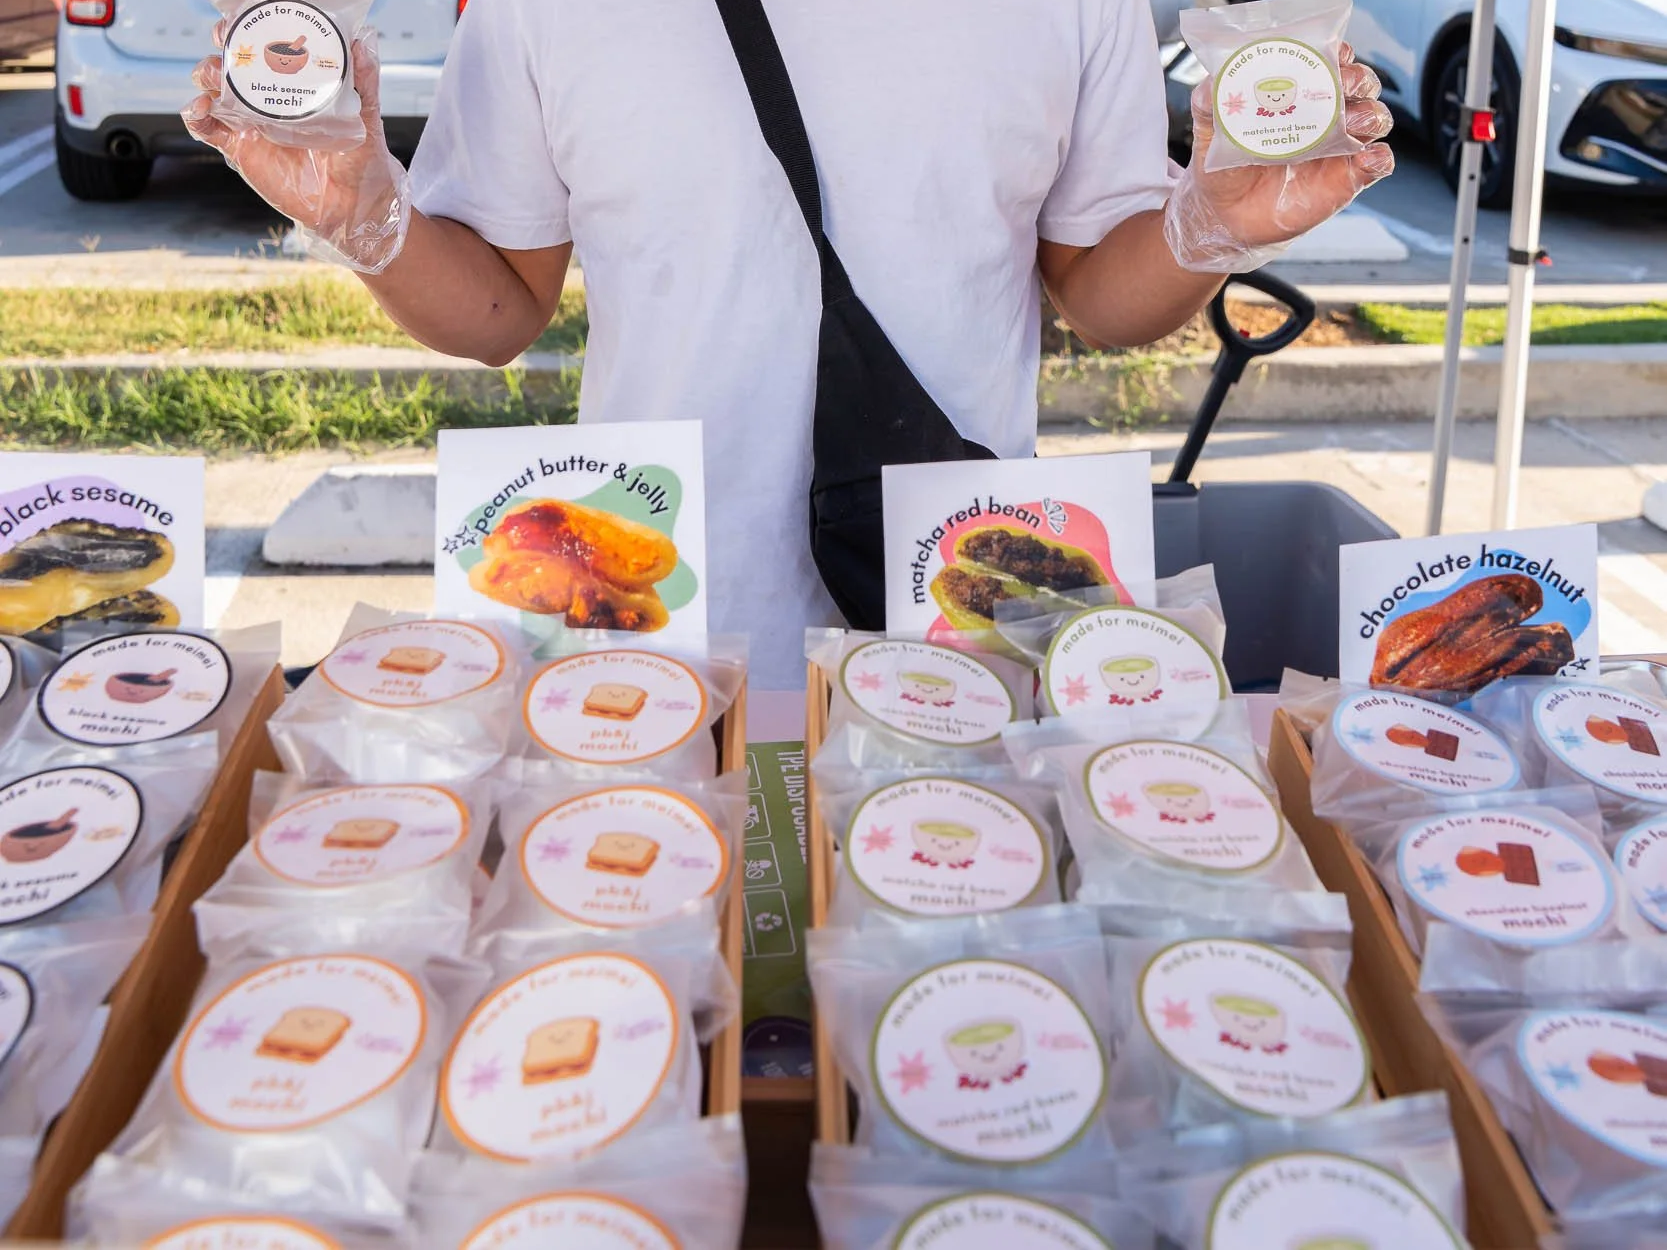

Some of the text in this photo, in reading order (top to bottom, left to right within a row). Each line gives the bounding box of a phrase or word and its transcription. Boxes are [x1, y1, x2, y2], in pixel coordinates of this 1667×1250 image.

[243, 6, 332, 38] made for meimei
[1228, 46, 1320, 78] made for meimei
[251, 82, 316, 95] black sesame
[264, 96, 303, 106] mochi
[1242, 123, 1317, 136] matcha red bean
[1261, 133, 1300, 147] mochi
[475, 455, 669, 535] peanut butter & jelly
[71, 485, 173, 526] sesame
[911, 496, 1041, 604] matcha red bean
[1360, 544, 1585, 639] chocolate hazelnut
[1062, 616, 1185, 654] made for meimei
[92, 638, 218, 670] made for meimei
[1545, 691, 1570, 712] made
[1568, 689, 1593, 698] for
[68, 708, 107, 720] black
[1354, 696, 1482, 736] made for meimei
[80, 723, 142, 735] mochi
[906, 720, 963, 736] mochi
[1409, 771, 1469, 788] mochi
[0, 786, 28, 806] de
[1412, 815, 1553, 849] made for meimei
[1648, 829, 1667, 840] fo
[0, 888, 50, 907] ochi
[1502, 913, 1568, 929] mochi
